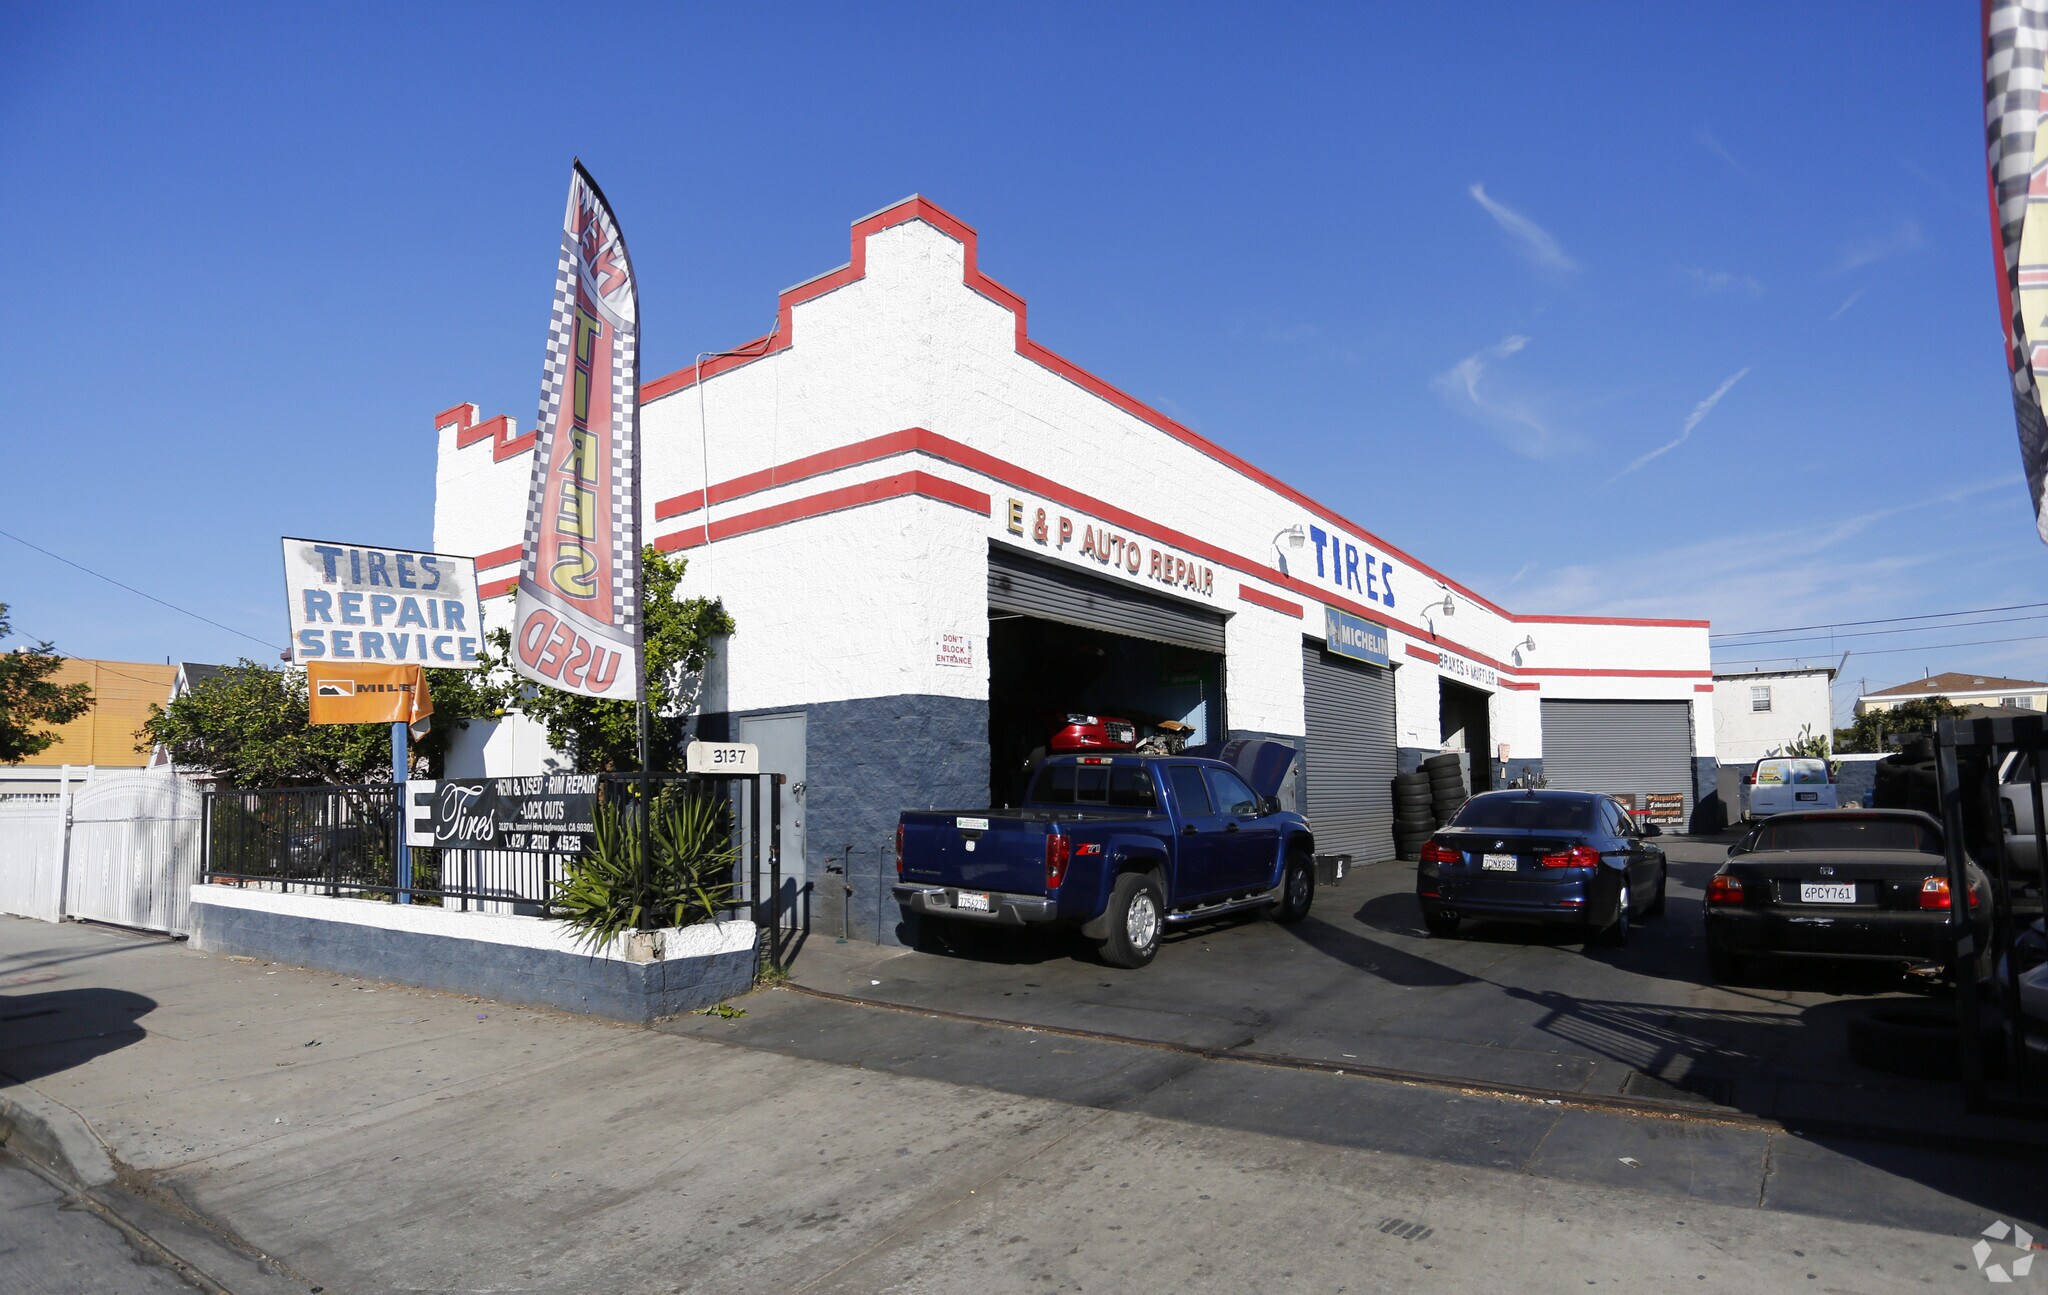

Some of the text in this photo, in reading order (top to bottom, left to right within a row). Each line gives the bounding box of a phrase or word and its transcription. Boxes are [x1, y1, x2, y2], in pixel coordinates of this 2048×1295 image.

[1008, 498, 1214, 595] E & P AUTO REPAIR
[314, 545, 441, 590] TIRES
[1309, 524, 1395, 608] TIRES
[302, 588, 466, 632] REPAIR
[298, 628, 477, 662] SERVICE
[942, 644, 965, 654] BLOCK
[943, 634, 963, 643] DON'T
[1341, 624, 1388, 656] MICHELIN
[936, 654, 972, 665] ENTRANCE
[1438, 652, 1465, 676] BRAKES
[1470, 663, 1496, 686] MUFFLER
[713, 749, 746, 763] 3137
[513, 778, 521, 796] &
[521, 776, 543, 795] USED
[548, 775, 565, 795] RIM
[565, 774, 597, 794] REPAIR
[406, 780, 495, 847] E Tires
[522, 801, 565, 820] LOCK OUTS
[568, 823, 577, 832] CA
[577, 823, 594, 832] 90301
[1075, 843, 1101, 856] Z71
[1804, 887, 1852, 899] 6PCY761
